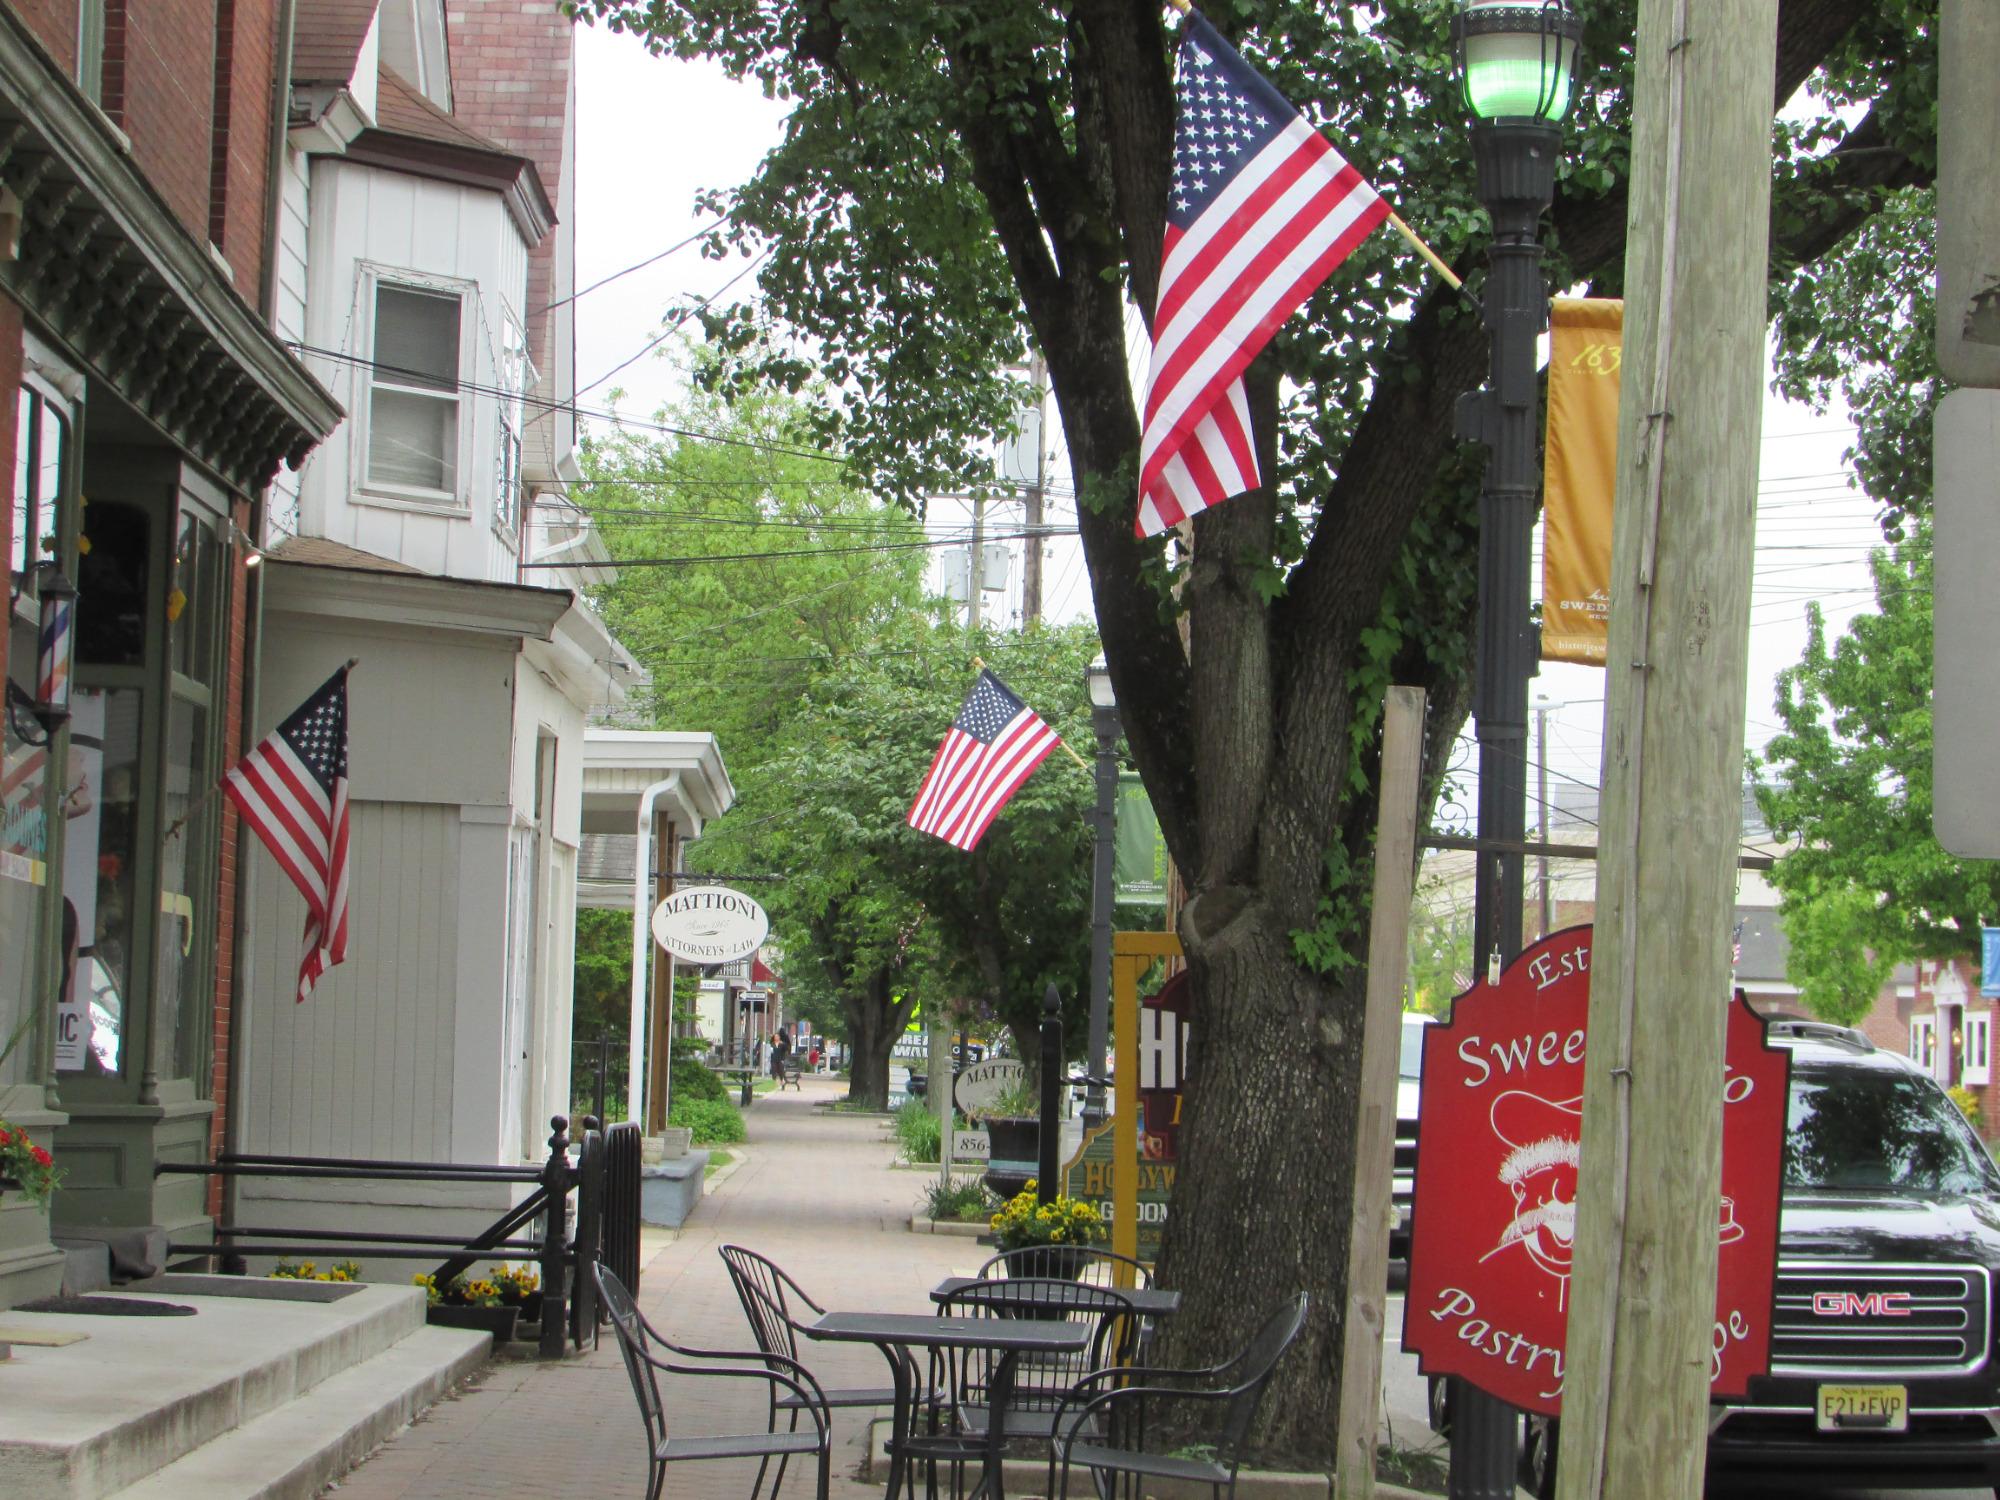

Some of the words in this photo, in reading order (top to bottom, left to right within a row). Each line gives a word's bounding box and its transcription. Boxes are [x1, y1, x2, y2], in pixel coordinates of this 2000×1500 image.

[665, 892, 757, 920] MATTIONI
[663, 935, 725, 957] ATTORNEYS
[733, 937, 756, 954] LAW
[1813, 1293, 1911, 1316] GMC
[1430, 1287, 1567, 1398] Pastry
